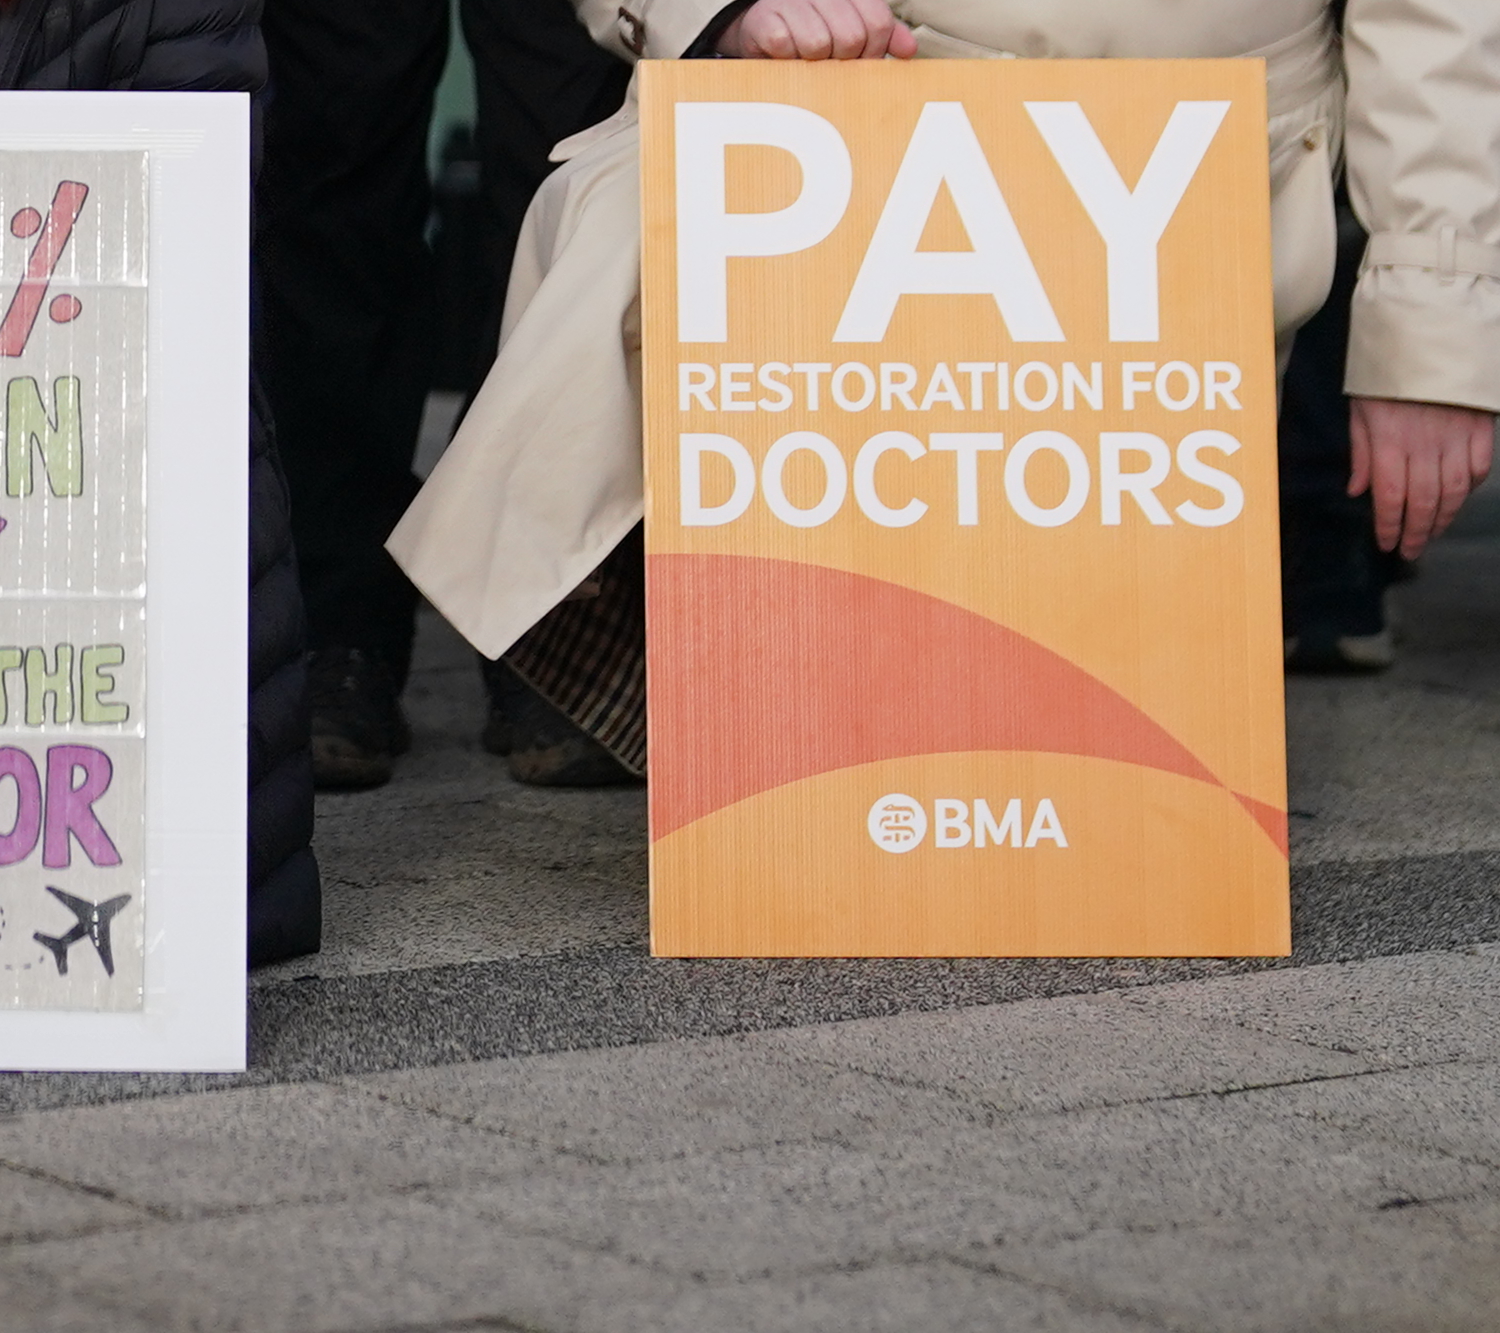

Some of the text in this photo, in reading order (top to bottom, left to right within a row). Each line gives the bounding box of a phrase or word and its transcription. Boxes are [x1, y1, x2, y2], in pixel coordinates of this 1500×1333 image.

[675, 101, 1232, 343] PAY
[677, 360, 1243, 412] RESTORATION FOR
[679, 429, 1245, 528] DOCTORS
[934, 798, 1069, 849] BMA
